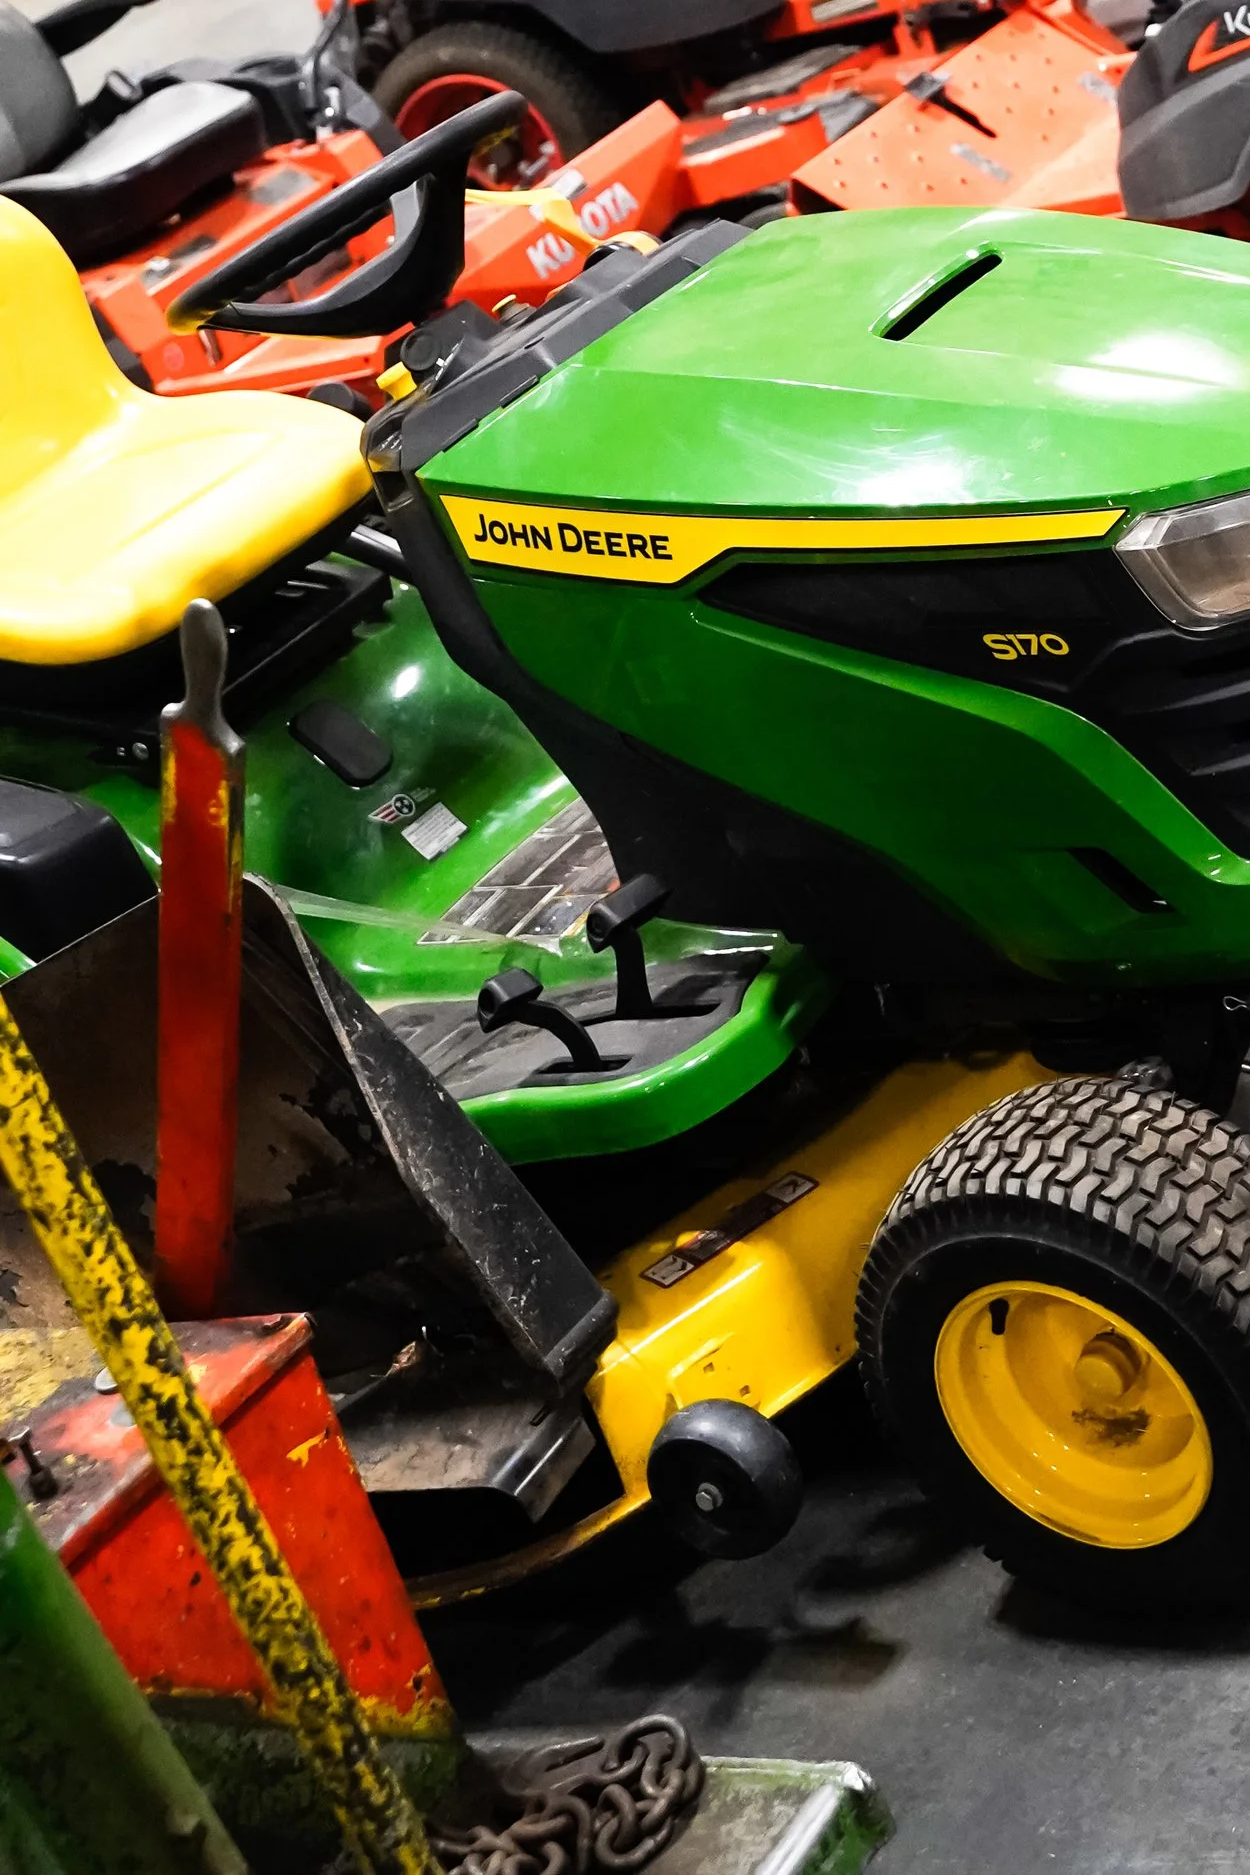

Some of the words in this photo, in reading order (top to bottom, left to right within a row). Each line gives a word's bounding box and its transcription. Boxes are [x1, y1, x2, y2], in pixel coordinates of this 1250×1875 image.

[525, 181, 640, 280] KUOTA
[474, 513, 554, 551] JOHN
[557, 522, 674, 561] DEERE
[982, 633, 1070, 661] S170
